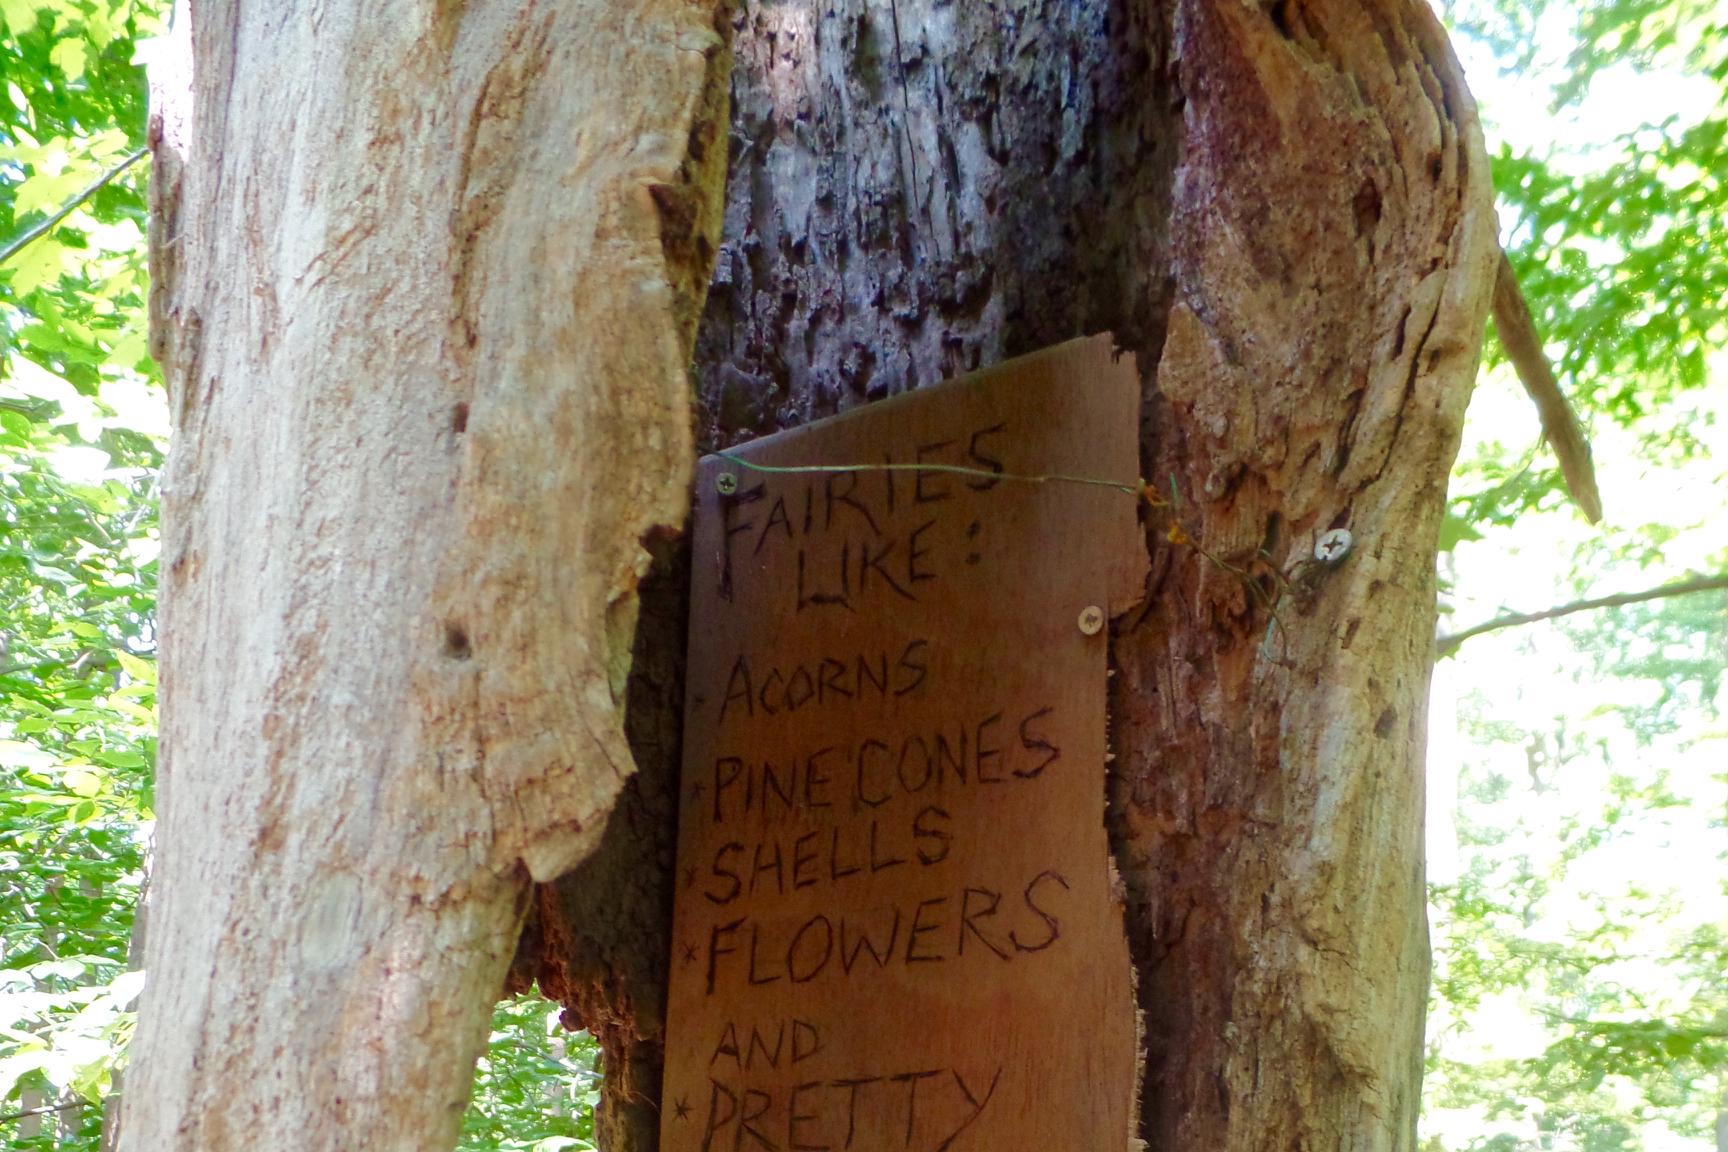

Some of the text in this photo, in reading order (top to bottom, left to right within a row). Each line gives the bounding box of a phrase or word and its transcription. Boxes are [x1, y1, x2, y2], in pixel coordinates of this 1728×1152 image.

[718, 423, 1004, 602] FAIRIES
[719, 640, 928, 724] ACORNS
[705, 806, 954, 905] SHELLS
[706, 870, 1070, 995] FLOWERS
[710, 1019, 823, 1069] AND
